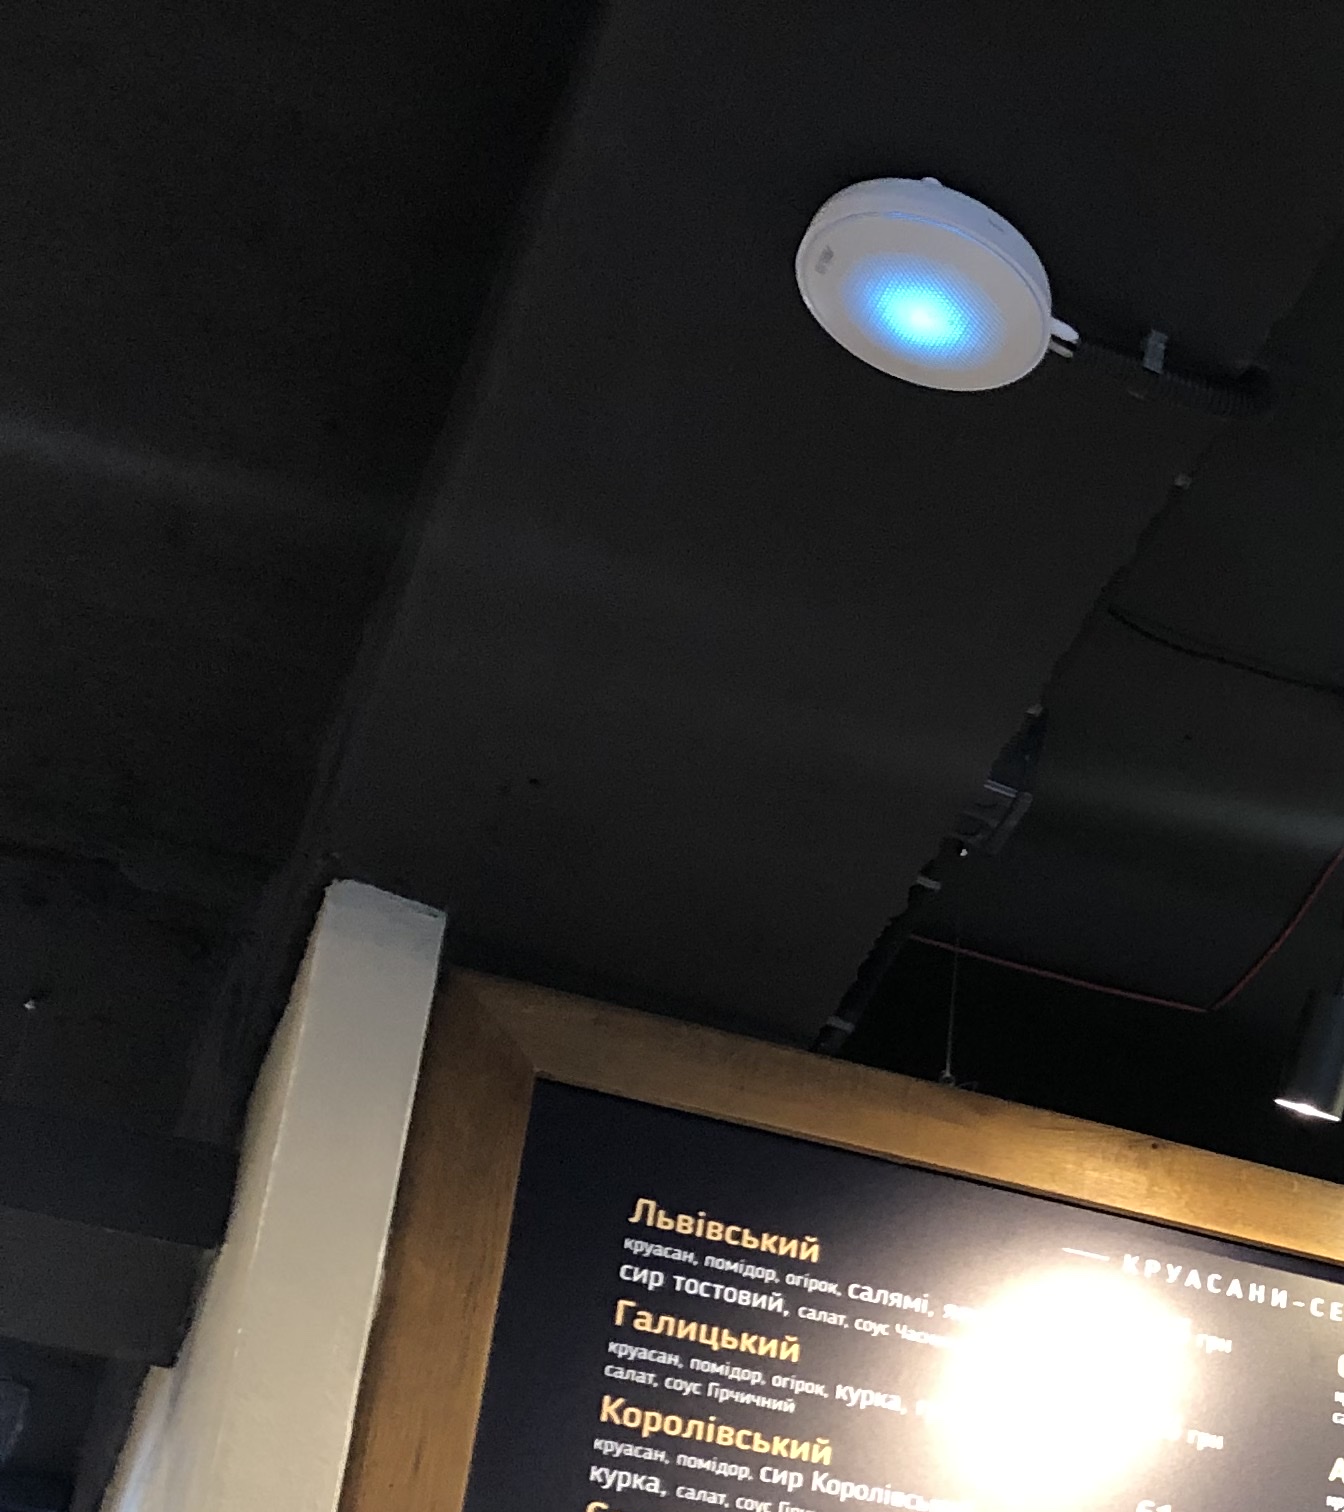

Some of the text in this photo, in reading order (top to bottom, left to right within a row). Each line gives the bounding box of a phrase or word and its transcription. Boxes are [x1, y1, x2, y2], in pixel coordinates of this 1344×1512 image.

[628, 1197, 819, 1263] Львівський
[614, 1299, 800, 1362] Галицький
[599, 1394, 832, 1465] Королівський
